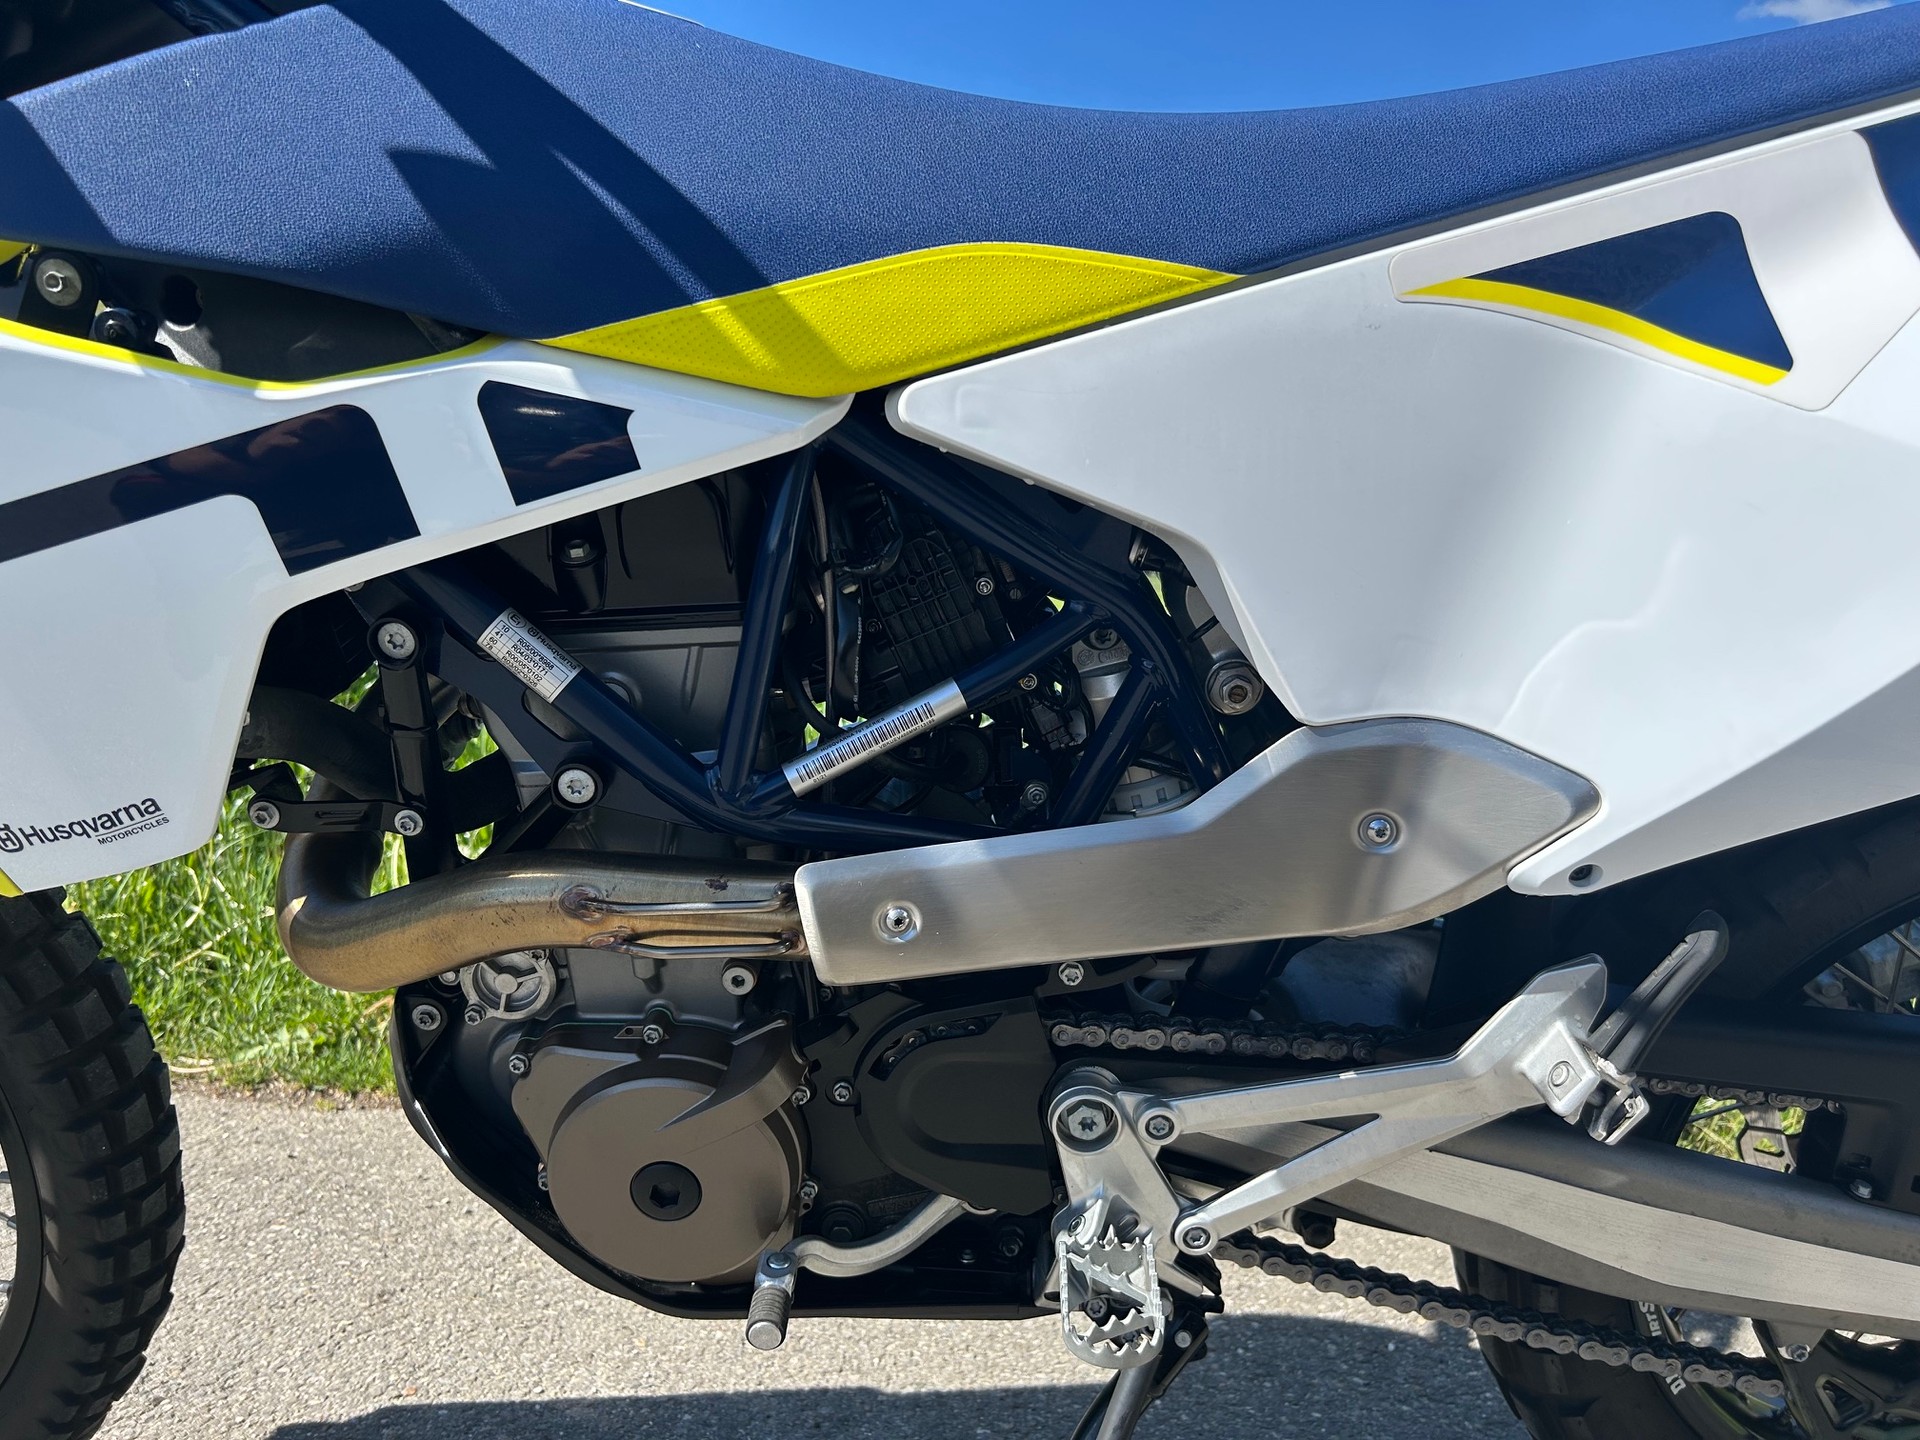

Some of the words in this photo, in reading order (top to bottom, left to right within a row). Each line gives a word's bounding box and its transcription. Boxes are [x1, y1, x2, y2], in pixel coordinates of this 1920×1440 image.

[495, 630, 504, 639] 41
[501, 624, 510, 634] 10
[488, 636, 498, 645] 60
[537, 633, 578, 671] Husqvarna
[18, 797, 162, 847] Husqvarna
[97, 816, 170, 845] MOTORCYCLES
